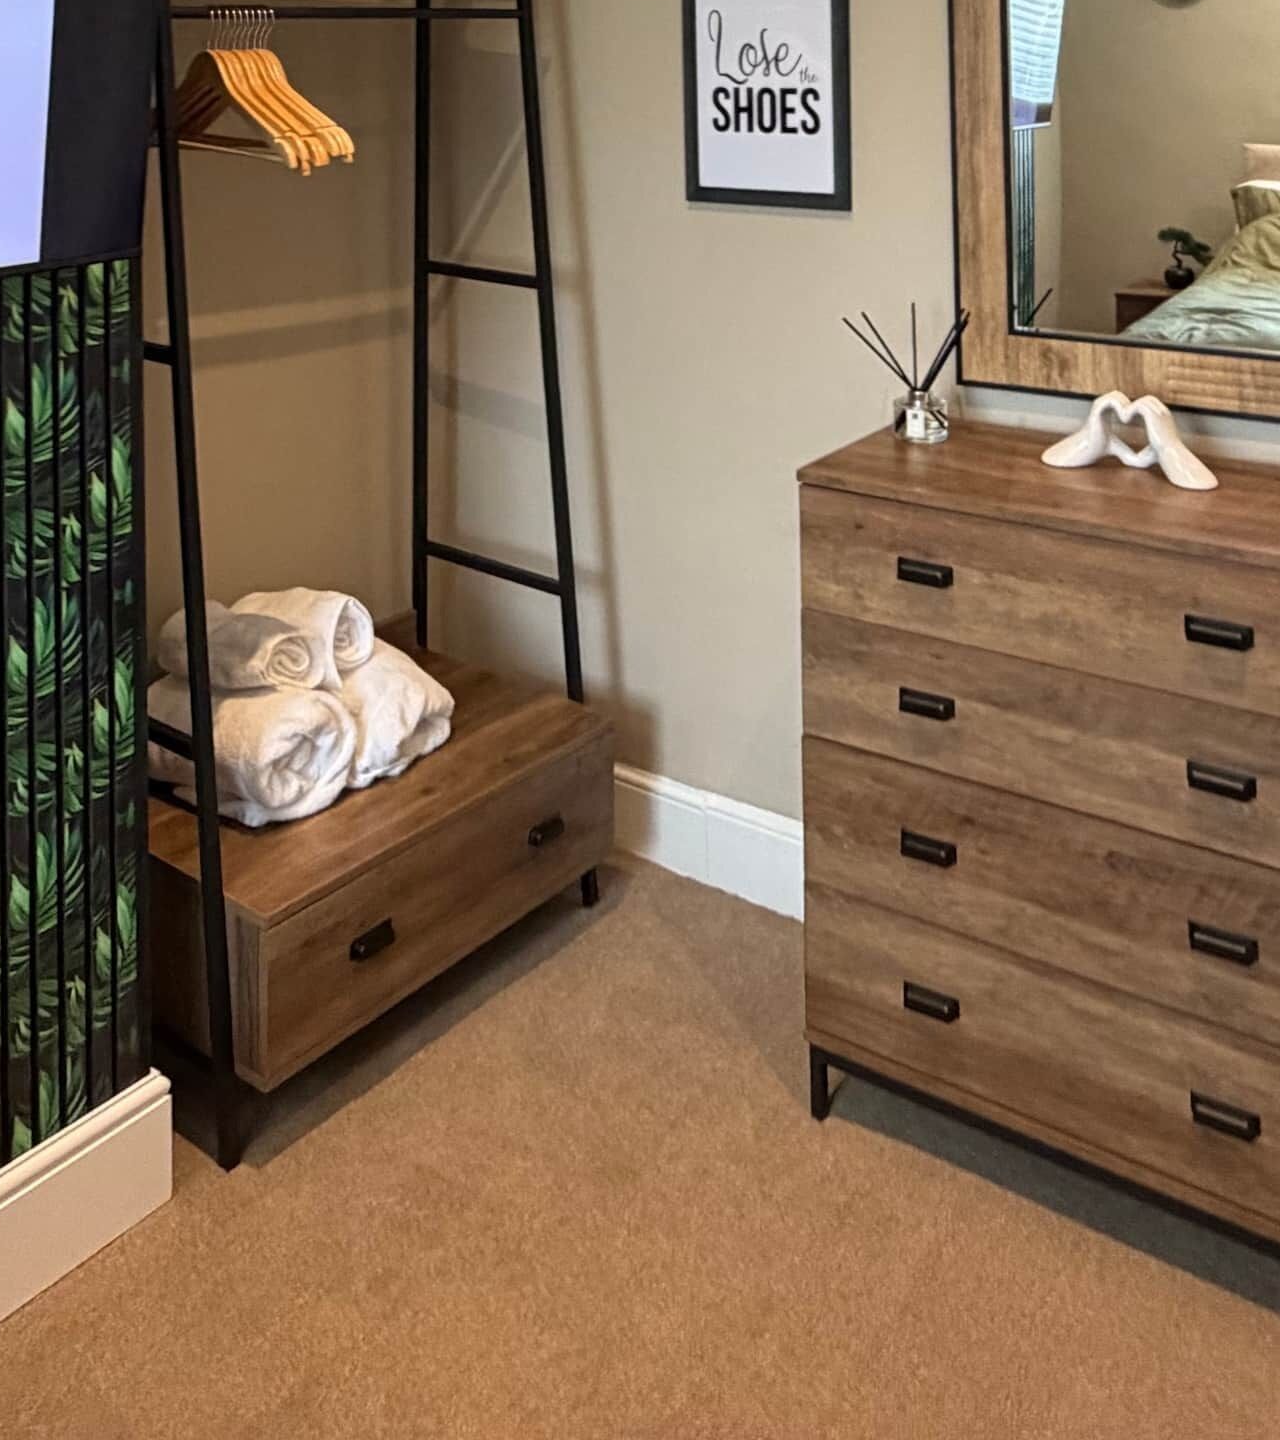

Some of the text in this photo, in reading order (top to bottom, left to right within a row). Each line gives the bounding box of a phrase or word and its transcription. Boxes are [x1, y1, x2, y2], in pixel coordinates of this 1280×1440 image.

[707, 9, 818, 85] Lose the
[712, 86, 821, 136] SHOES
